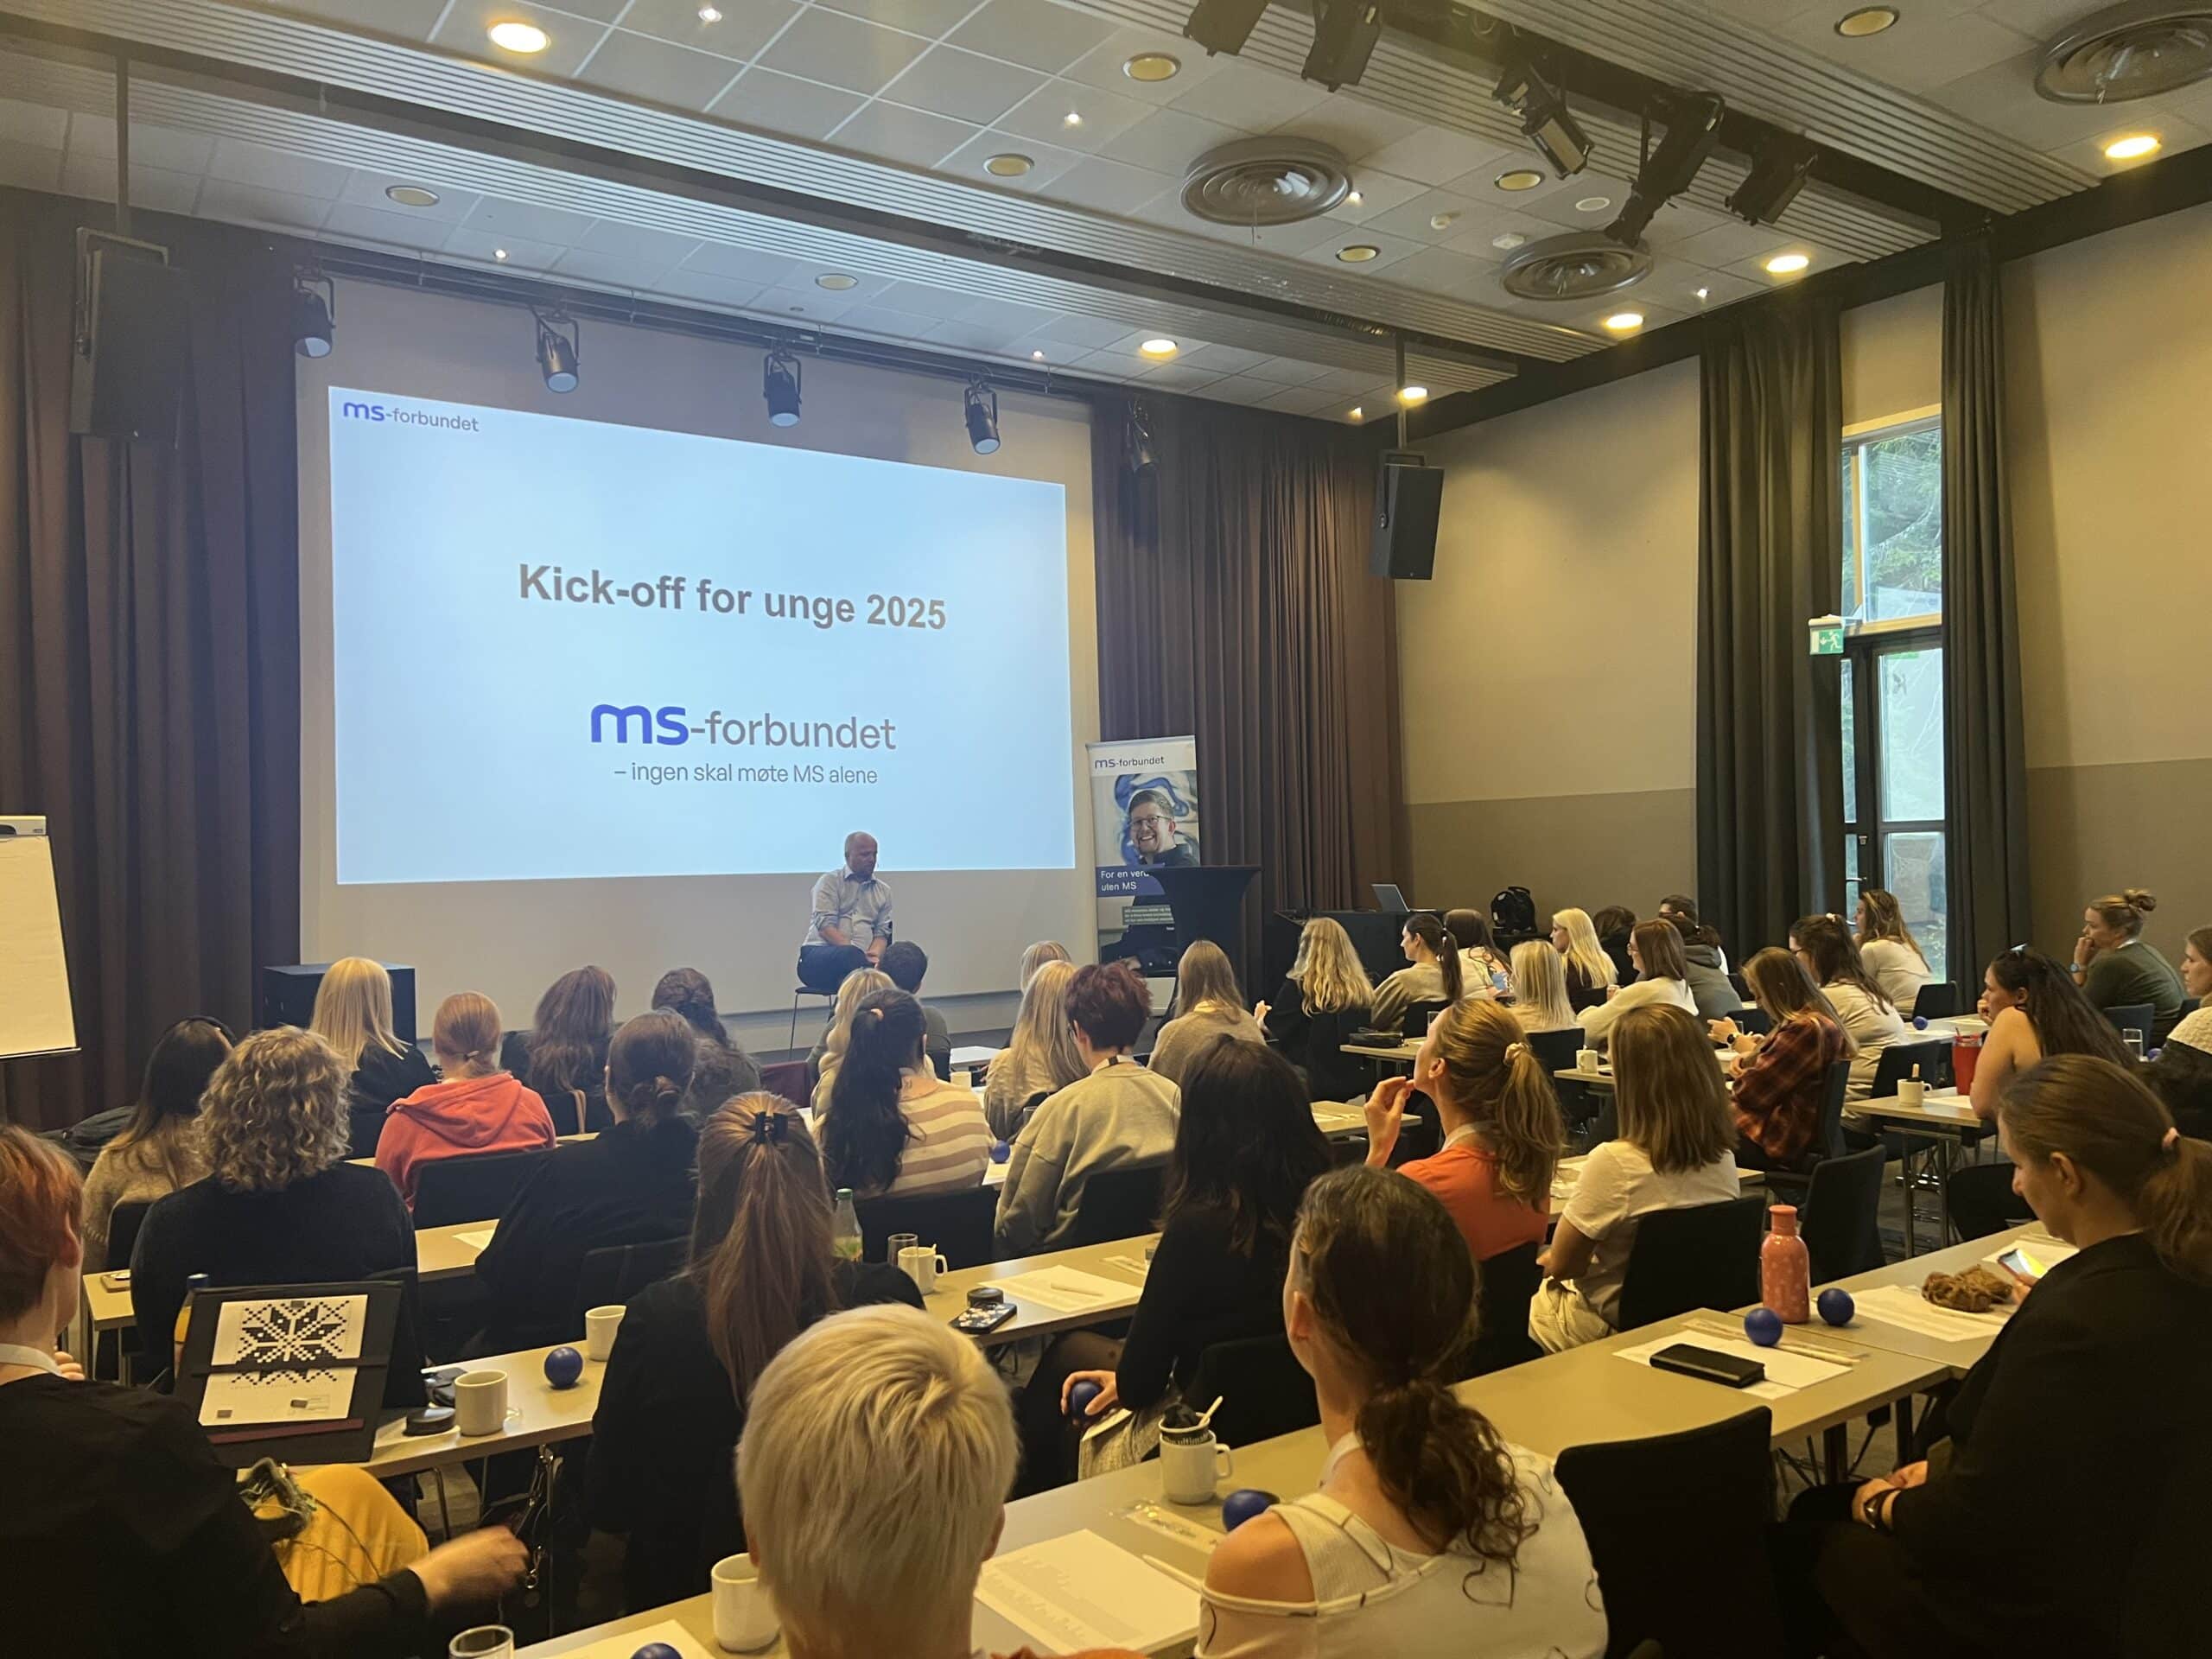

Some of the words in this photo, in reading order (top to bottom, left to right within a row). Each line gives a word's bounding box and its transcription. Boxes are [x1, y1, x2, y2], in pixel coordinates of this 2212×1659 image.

[342, 401, 480, 433] ms-forbundet
[519, 563, 687, 610] Kick-off
[696, 578, 753, 615] for
[764, 592, 855, 630] unge
[867, 594, 947, 630] 2025
[590, 703, 898, 750] ms-forbundet
[631, 761, 689, 786] ingen
[693, 762, 733, 782] skal
[737, 766, 789, 783] møte
[793, 764, 825, 784] MS
[829, 765, 878, 785] alene
[1094, 756, 1165, 769] ms-forbundet
[1101, 870, 1115, 879] For
[1101, 882, 1120, 892] uten
[1122, 881, 1137, 891] MS
